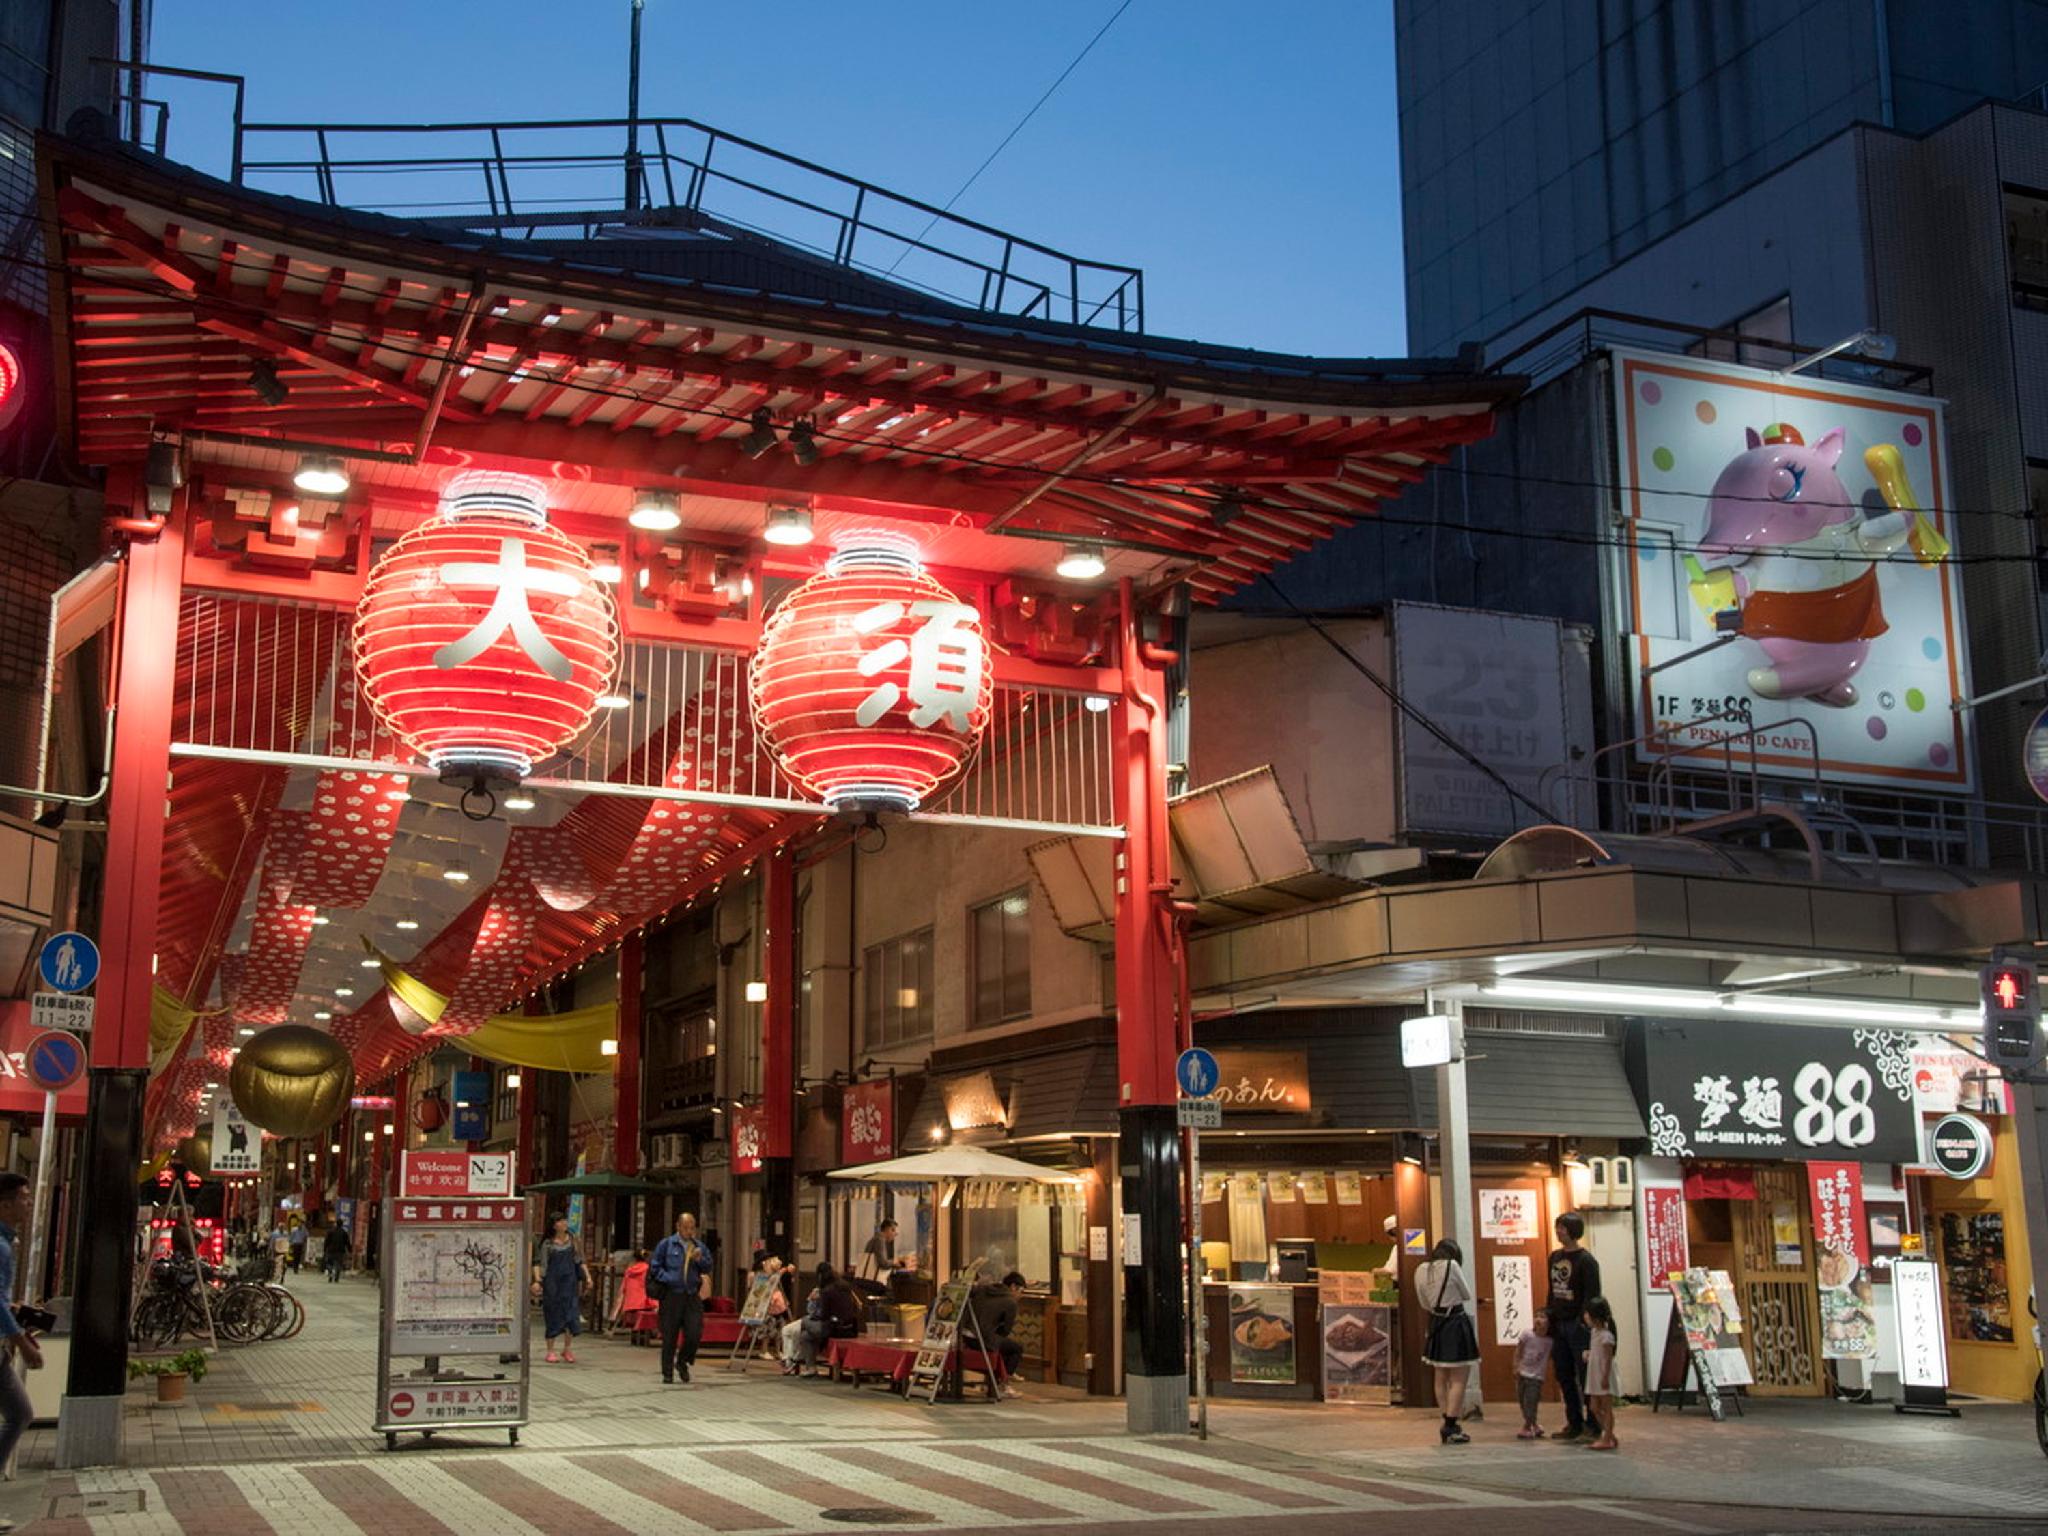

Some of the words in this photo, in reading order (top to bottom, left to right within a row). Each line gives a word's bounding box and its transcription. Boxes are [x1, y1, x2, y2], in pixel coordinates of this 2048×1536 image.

[433, 538, 582, 683] 大
[852, 600, 983, 734] 須
[1657, 695, 1680, 716] 1F
[1771, 737, 1811, 751] CAFE
[39, 1011, 86, 1027] 11-22
[1196, 1077, 1287, 1104] のあん
[1182, 1114, 1217, 1125] 11-22
[1694, 1130, 1745, 1144] MU-MEN
[417, 1161, 463, 1172] Welcome
[471, 1160, 506, 1176] N-2
[426, 1390, 518, 1404] 車両進入禁止
